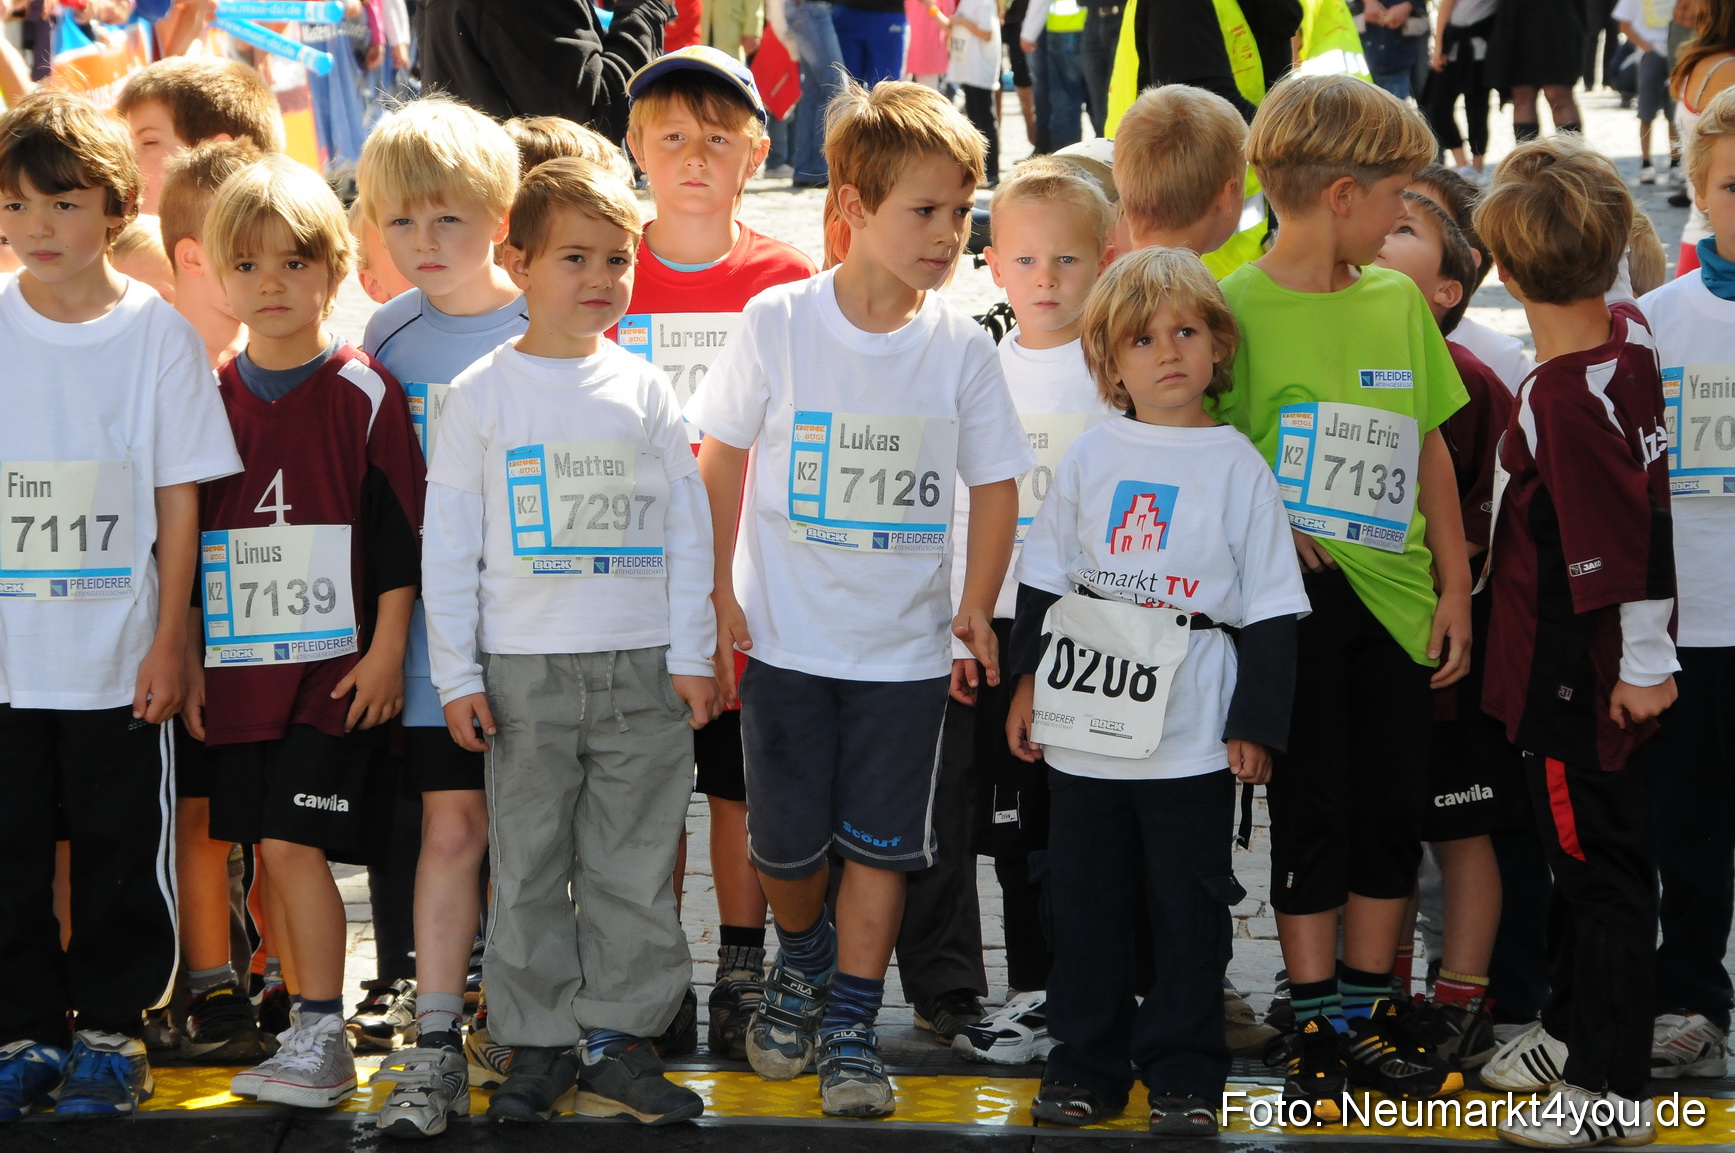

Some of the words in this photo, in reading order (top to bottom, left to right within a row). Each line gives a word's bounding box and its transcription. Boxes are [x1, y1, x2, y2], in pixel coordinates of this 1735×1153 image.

[660, 324, 728, 348] Lorenz
[1690, 374, 1735, 399] Yani
[840, 423, 900, 451] Lukas
[1326, 412, 1361, 442] Jan
[1367, 418, 1399, 449] Eric
[1691, 416, 1735, 451] 70
[554, 452, 625, 479] Matteo
[1284, 445, 1304, 466] K2
[797, 461, 818, 481] K2
[1324, 454, 1406, 504] 7133
[8, 472, 51, 498] Finn
[840, 467, 940, 507] 7126
[1018, 465, 1052, 501] 0
[254, 469, 292, 527] 4
[516, 495, 538, 514] K2
[560, 493, 656, 530] 7297
[11, 515, 119, 552] 7117
[806, 527, 847, 542] BOCK
[890, 532, 945, 544] PFLEIDERER
[1361, 525, 1404, 543] PFLEIDERER
[235, 539, 282, 564] Linus
[611, 556, 663, 568] PFLEIDERER
[533, 559, 571, 569] BOCK
[70, 577, 131, 589] PFLEIDERER
[207, 582, 223, 601] K2
[1165, 575, 1200, 598] TV
[240, 577, 336, 618] 7139
[220, 648, 253, 659] BOCK
[291, 636, 353, 652] PFLEIDERER
[1047, 637, 1160, 702] 0208
[1035, 710, 1075, 725] PFLEIDERER
[1089, 718, 1125, 732] BOCK
[293, 793, 349, 812] cawila
[1434, 784, 1494, 808] cawila
[790, 981, 813, 996] FILA
[833, 1031, 858, 1039] FILA
